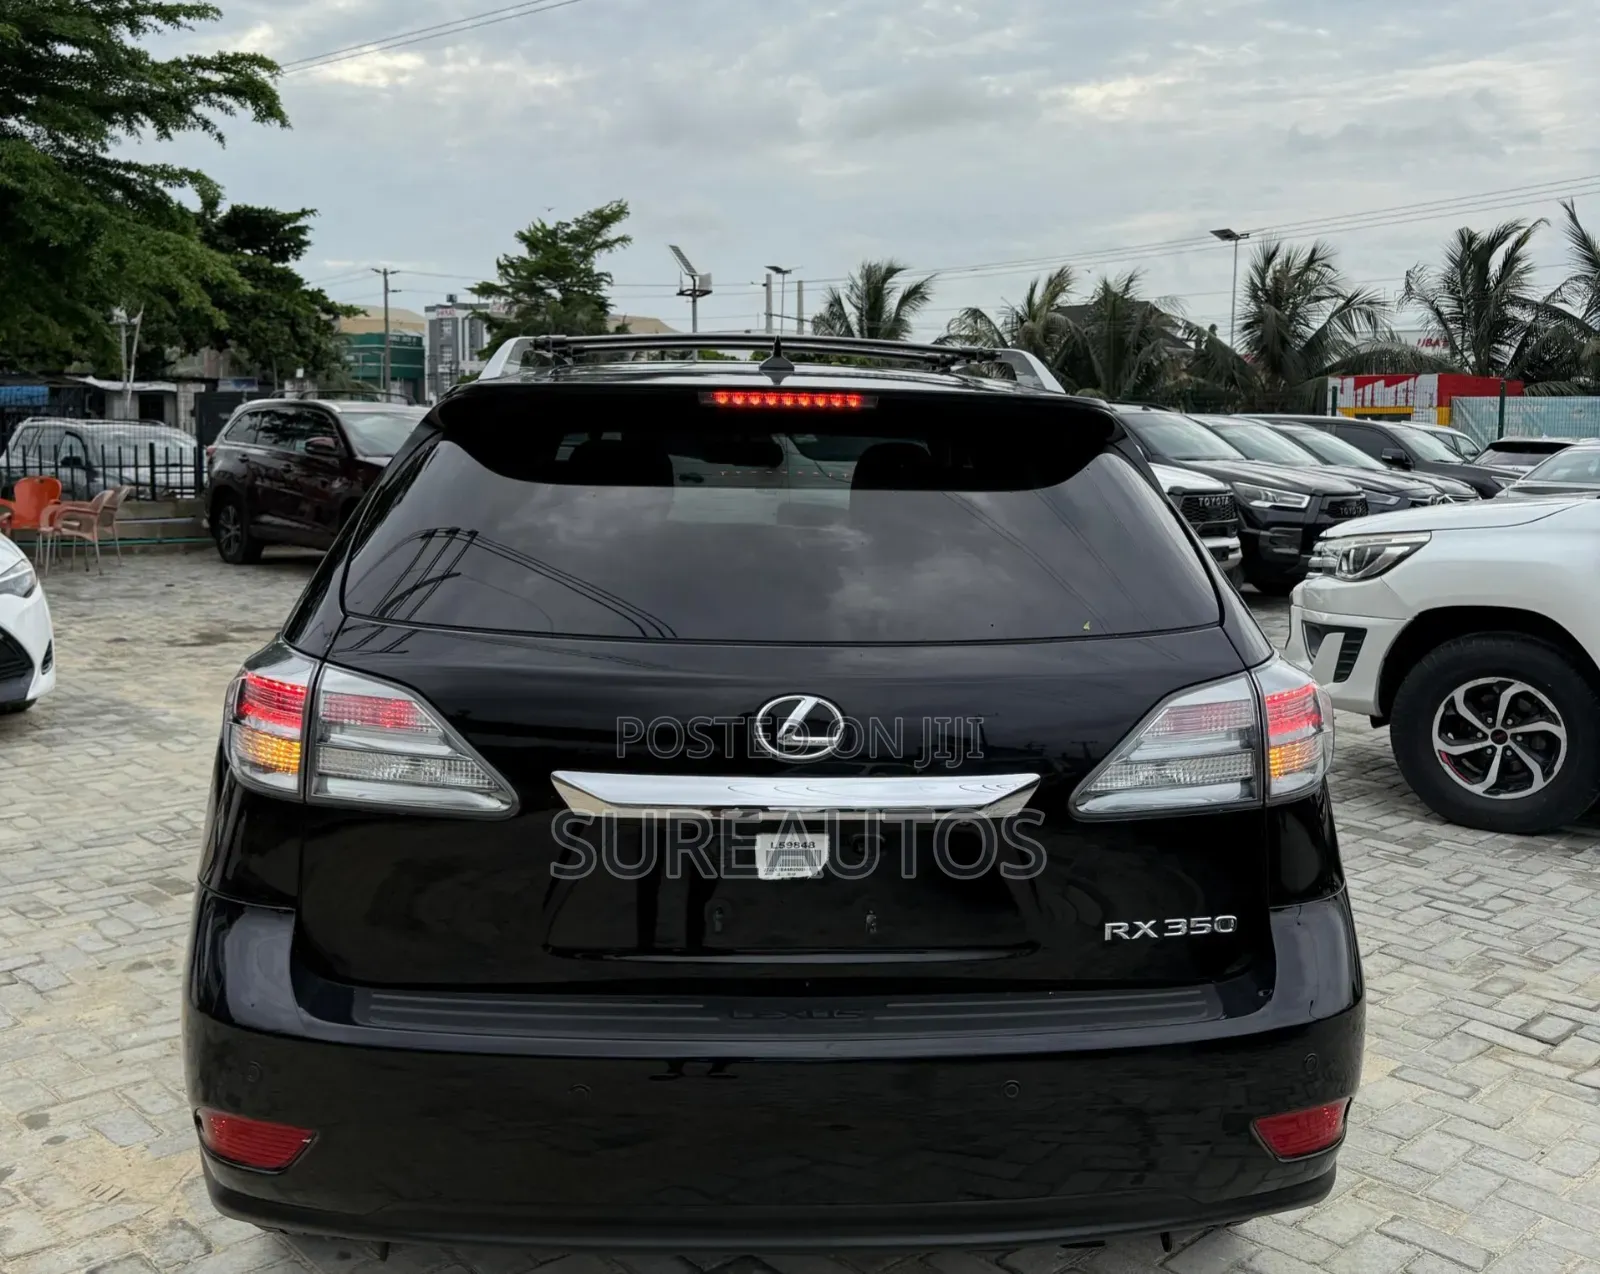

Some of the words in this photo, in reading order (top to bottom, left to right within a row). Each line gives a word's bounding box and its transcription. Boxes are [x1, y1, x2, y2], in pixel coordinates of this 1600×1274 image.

[1198, 496, 1229, 507] TOYOTA
[1104, 920, 1159, 941] RX
[1163, 915, 1238, 937] 350
